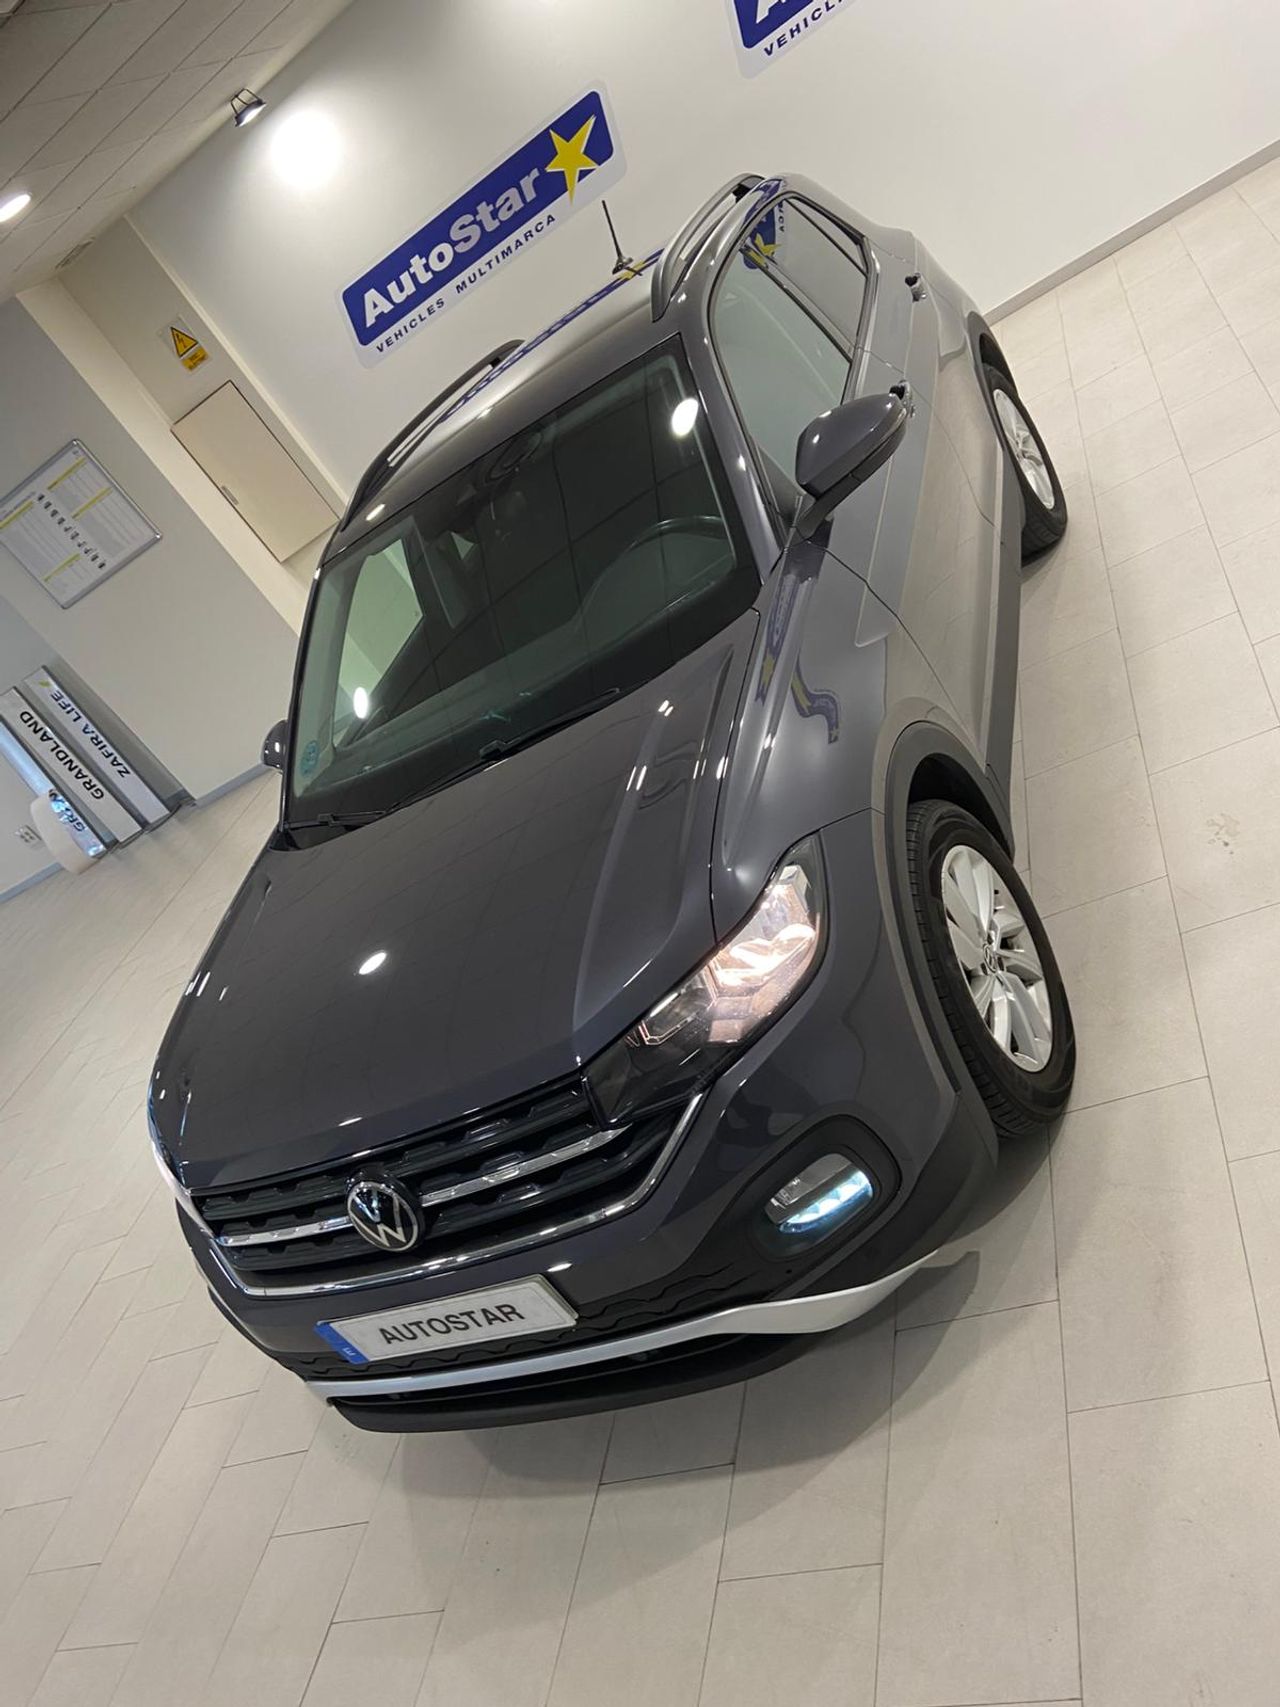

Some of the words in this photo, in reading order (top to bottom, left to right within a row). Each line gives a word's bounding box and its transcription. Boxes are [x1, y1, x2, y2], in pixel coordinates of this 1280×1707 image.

[764, 0, 844, 56] VEHICL
[364, 167, 540, 328] AutoStar
[376, 297, 445, 353] VEHICLES
[455, 214, 556, 294] MULTIMARCA
[51, 690, 82, 722] LIFE
[20, 710, 104, 800] GRANDLAND
[82, 723, 131, 778] ZAFIRA
[378, 1303, 525, 1345] AUTOSTAR
